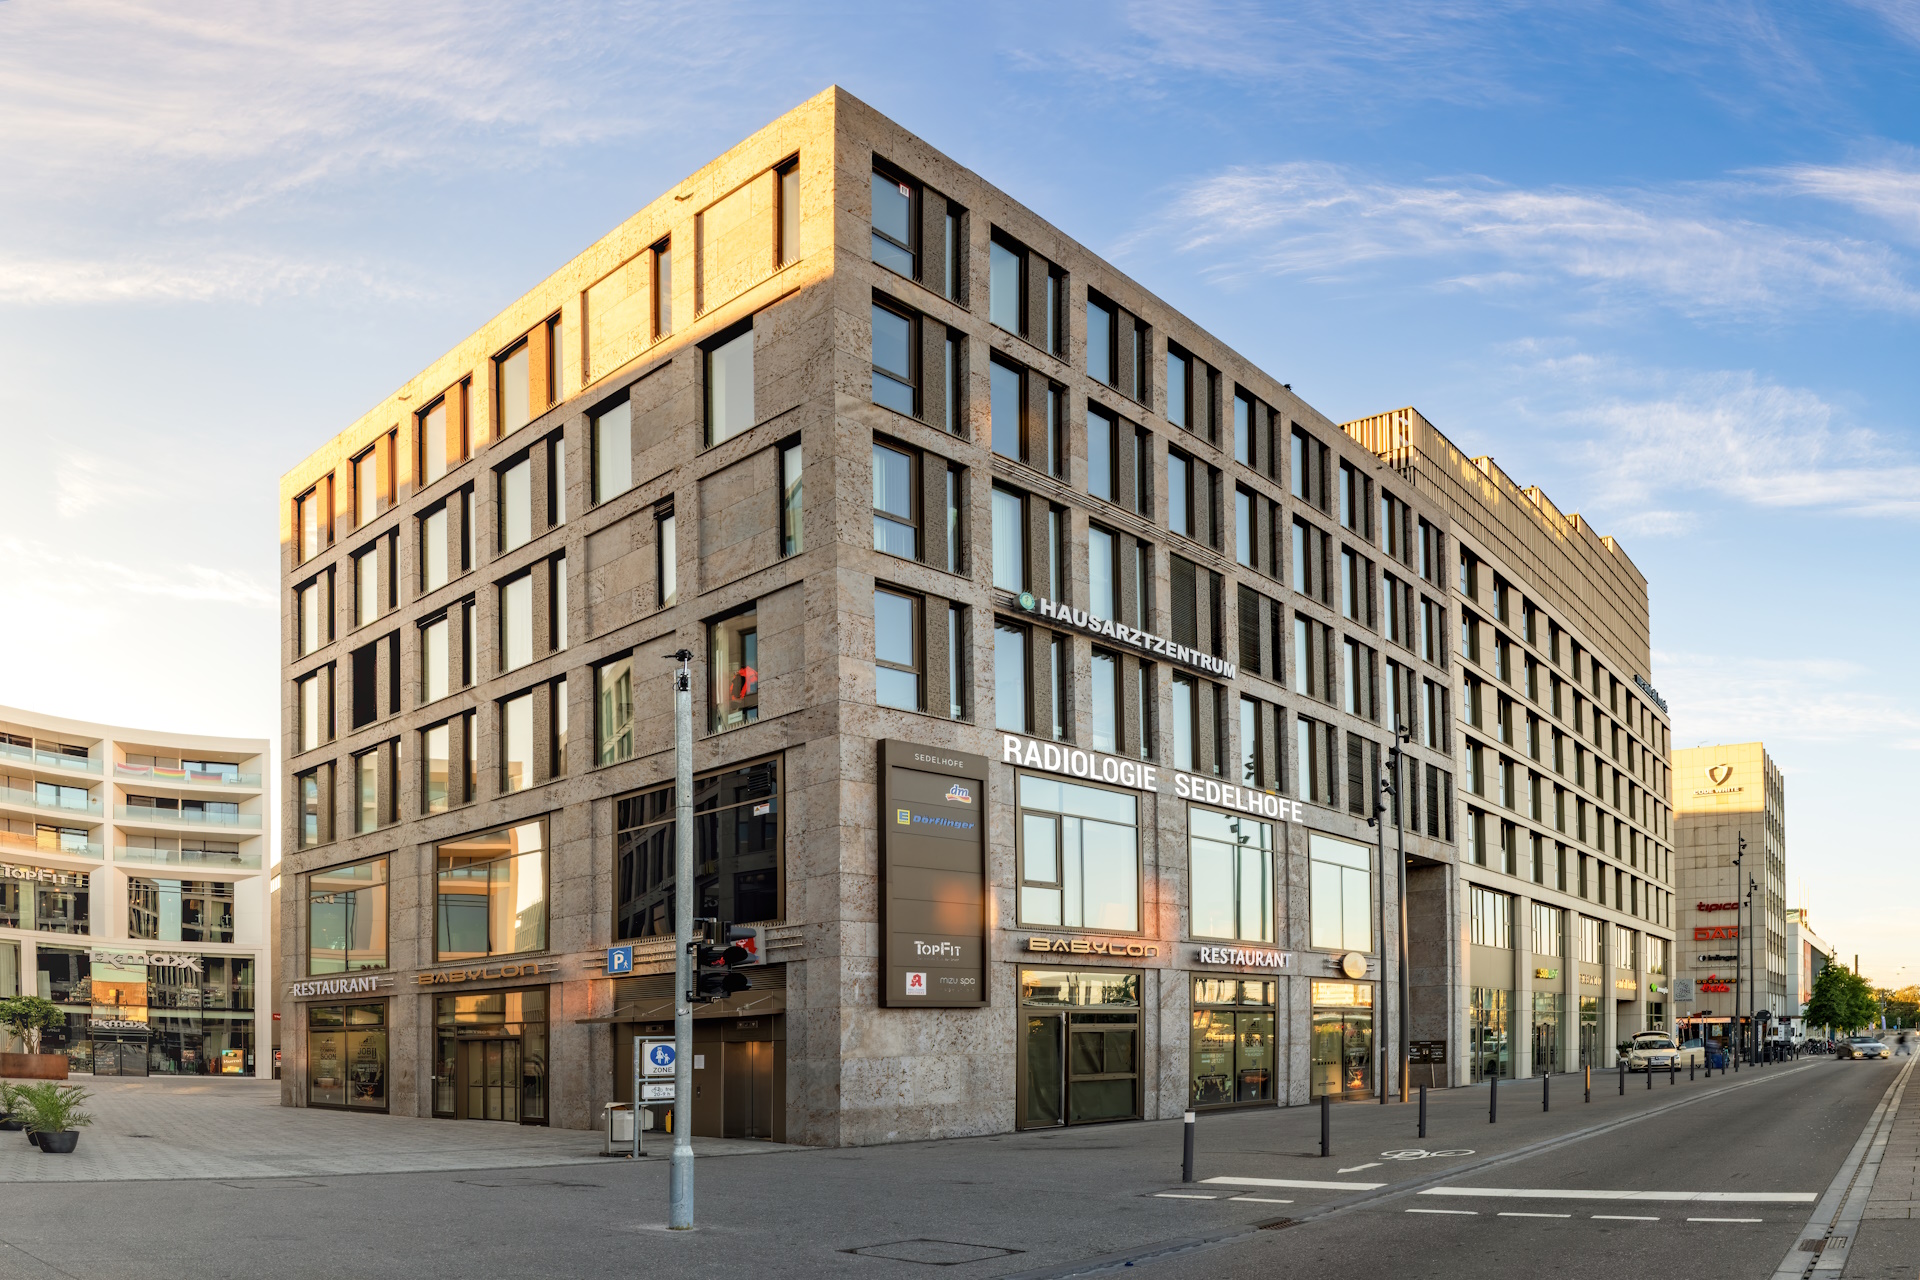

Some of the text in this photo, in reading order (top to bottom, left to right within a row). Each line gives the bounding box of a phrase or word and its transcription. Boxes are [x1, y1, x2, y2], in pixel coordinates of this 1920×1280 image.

[1040, 597, 1236, 680] HAUSARZTZENTRUM
[1003, 735, 1157, 792] RADIOLOGIE
[950, 785, 969, 797] dm
[1697, 902, 1739, 912] tipico
[614, 954, 624, 970] P
[1200, 946, 1292, 968] RESTAURANT
[293, 975, 379, 997] RESTAURANT
[960, 977, 976, 986] spa
